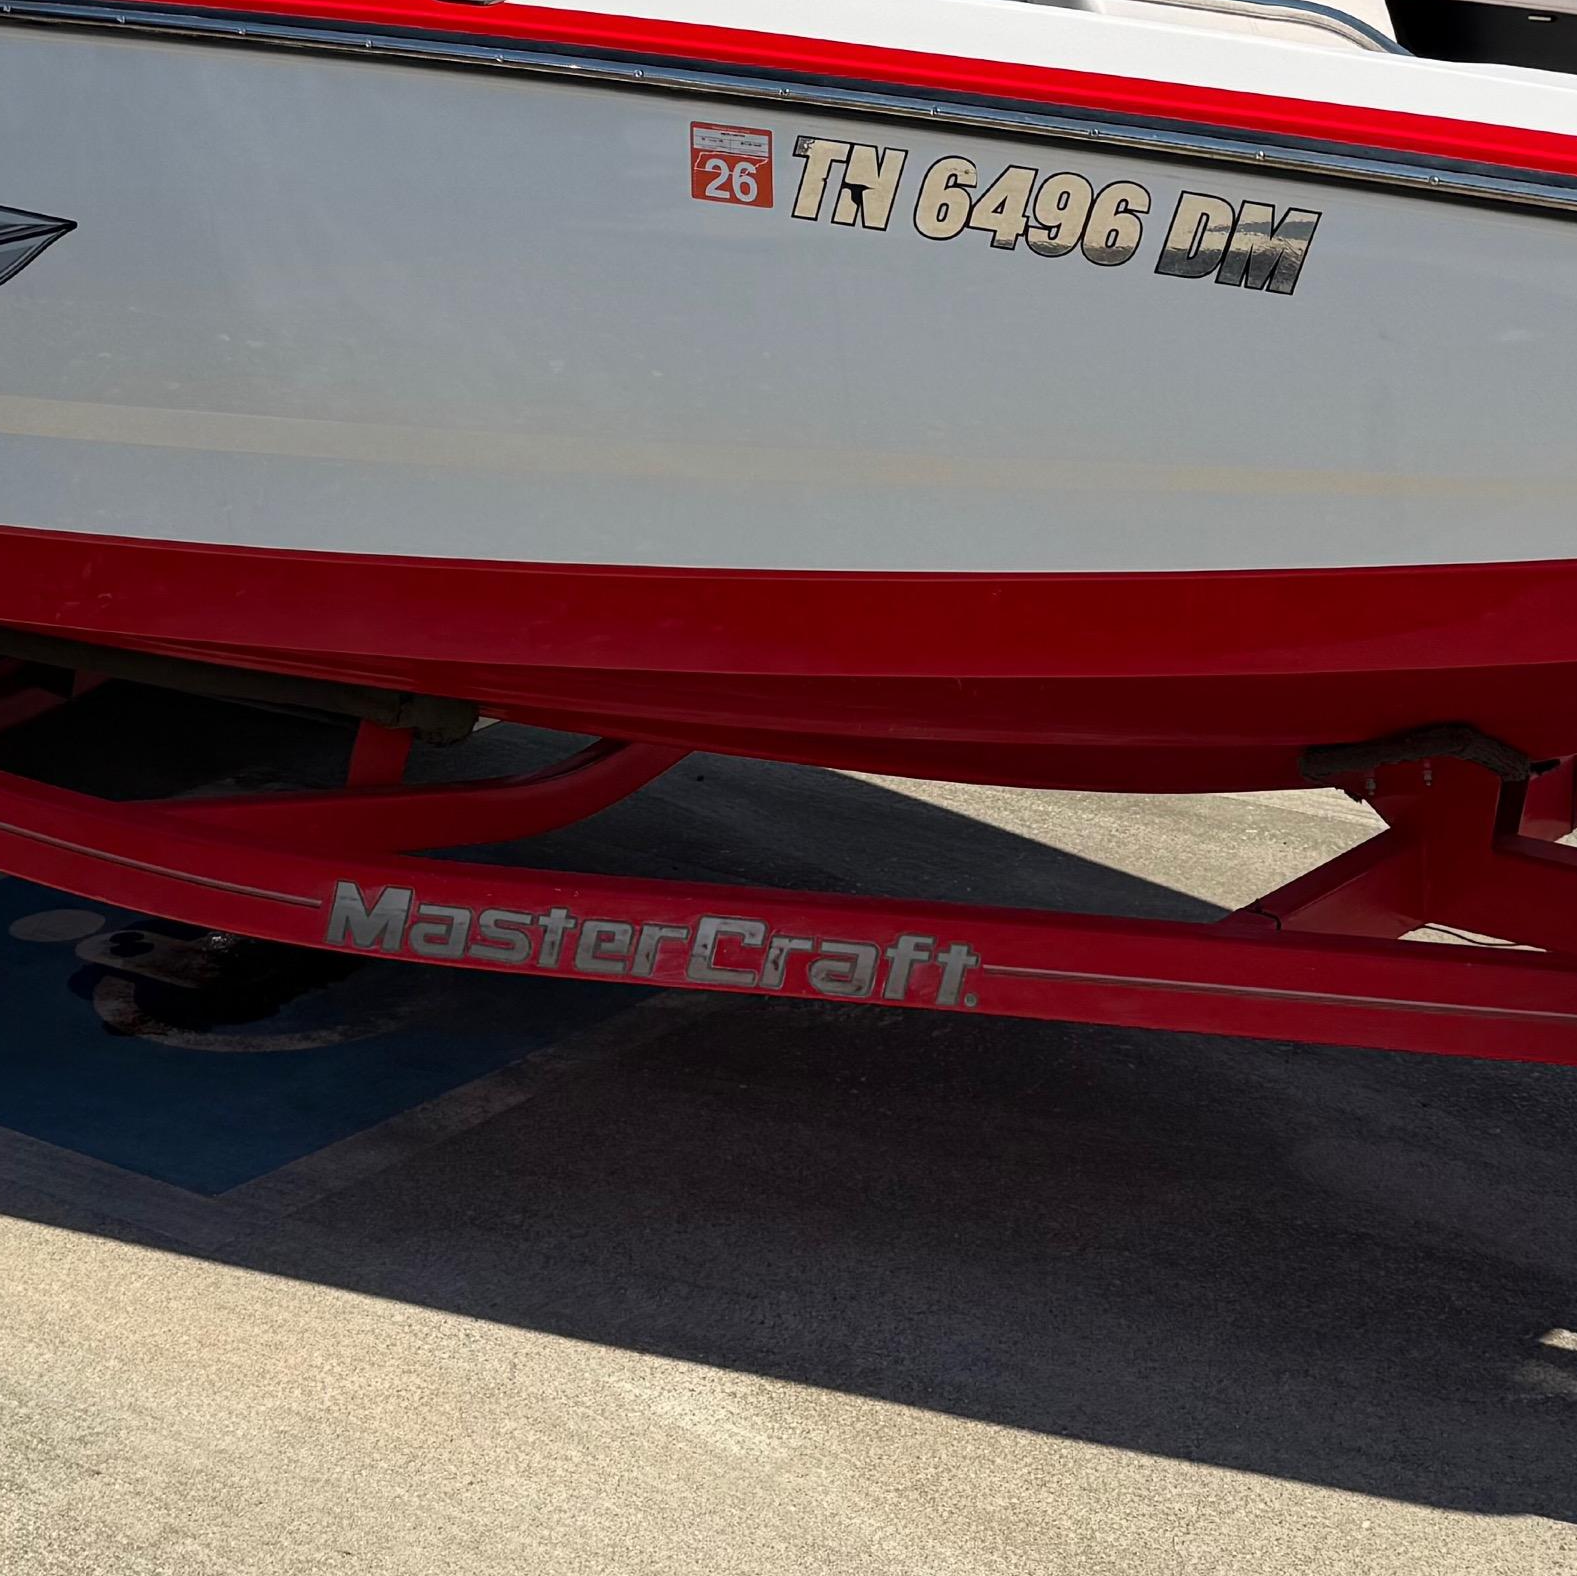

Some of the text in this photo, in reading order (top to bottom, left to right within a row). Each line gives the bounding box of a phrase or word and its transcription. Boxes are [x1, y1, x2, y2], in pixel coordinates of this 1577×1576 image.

[705, 158, 758, 202] 26
[791, 135, 1322, 295] TN 6496 DM
[326, 879, 980, 1008] MasterCraft
